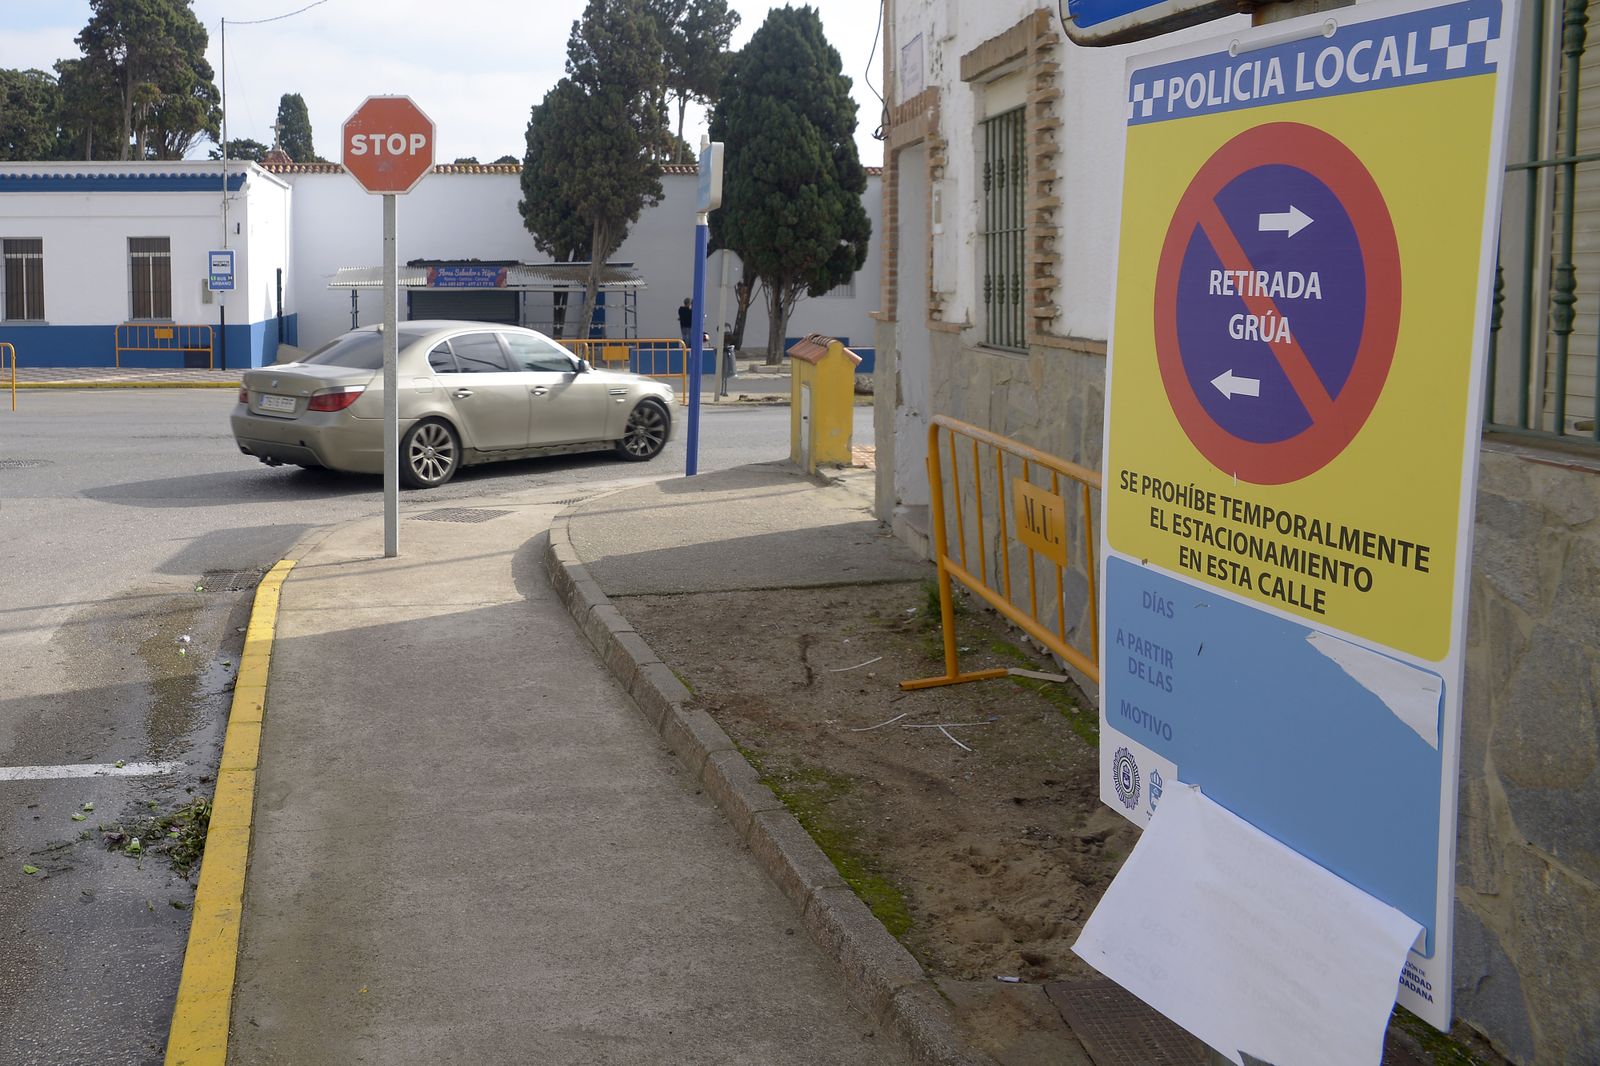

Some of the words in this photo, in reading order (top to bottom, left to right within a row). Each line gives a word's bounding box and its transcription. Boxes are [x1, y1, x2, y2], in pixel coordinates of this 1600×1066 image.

[1167, 57, 1285, 113] POLICIA
[1295, 31, 1428, 92] LOCAL
[350, 133, 427, 156] STOP
[1209, 270, 1322, 300] RETIRADA
[1228, 309, 1292, 344] GRÚA
[1120, 469, 1138, 493] SE
[1142, 475, 1216, 515] PROHÍBE
[1220, 495, 1430, 573] TEMPORALMENTE
[1150, 506, 1168, 532] EL
[1172, 513, 1374, 593] ESTACIONAMIENTO
[1179, 545, 1201, 572] EN
[1206, 554, 1252, 590] ESTA
[1258, 572, 1326, 615] CALLE
[1142, 590, 1174, 619] DÍAS
[1116, 627, 1125, 647] A
[1128, 632, 1174, 669] PARTIR
[1128, 656, 1145, 680] DE
[1148, 665, 1173, 693] LAS
[1120, 699, 1173, 742] MOTIVO
[1399, 975, 1434, 1004] DADANA
